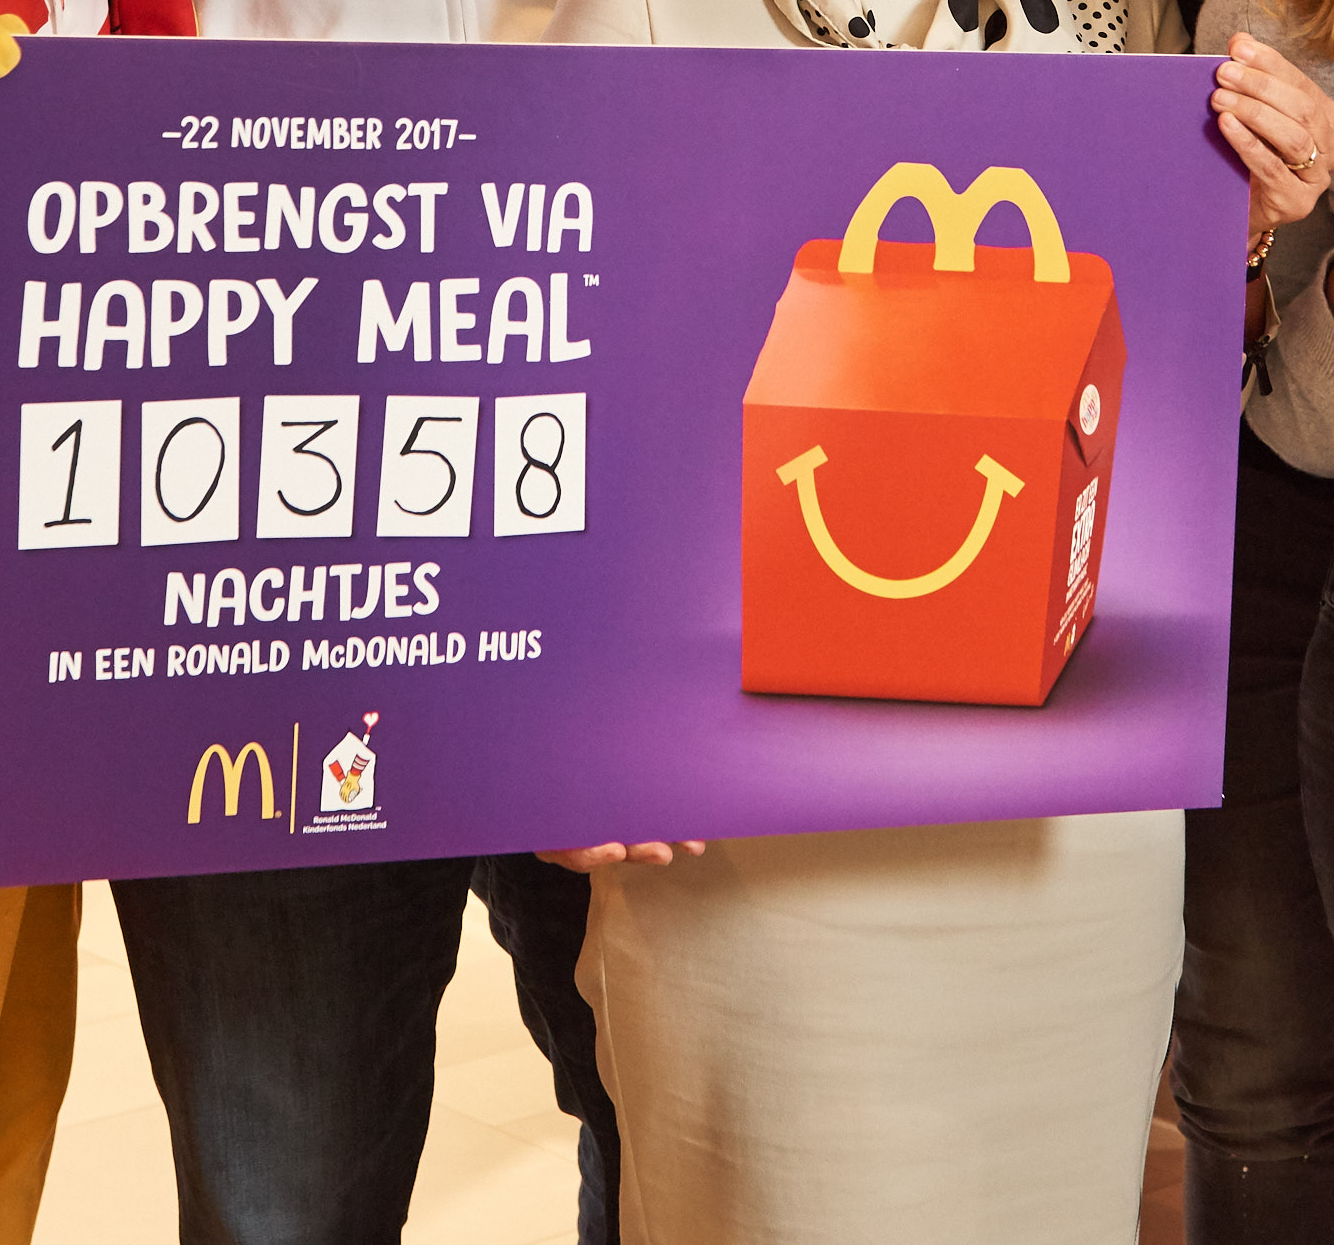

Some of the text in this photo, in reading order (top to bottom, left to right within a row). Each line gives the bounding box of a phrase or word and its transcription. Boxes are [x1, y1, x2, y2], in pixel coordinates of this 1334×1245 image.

[230, 116, 383, 150] NOVEMBER
[27, 181, 594, 254] OPBRENGST VIA
[17, 277, 319, 371] HAPPY
[163, 561, 441, 628] NACHTJES
[48, 629, 542, 684] IN EEN RONALD McDONALD HUIS
